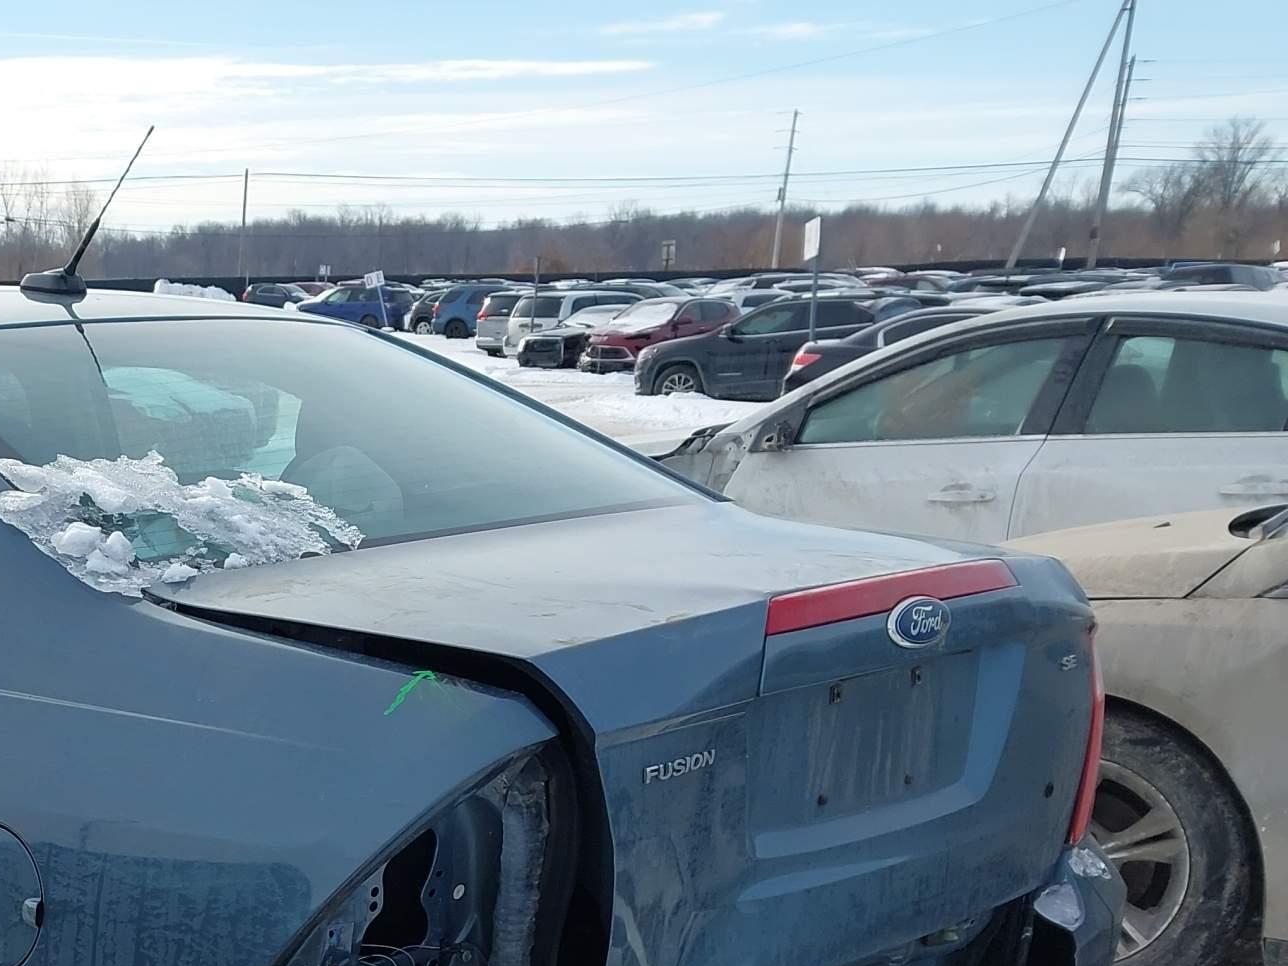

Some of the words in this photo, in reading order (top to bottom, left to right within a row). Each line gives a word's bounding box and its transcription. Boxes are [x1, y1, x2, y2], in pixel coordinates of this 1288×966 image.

[911, 605, 943, 636] Ford
[1062, 654, 1078, 671] SE
[644, 749, 716, 784] FUSION
